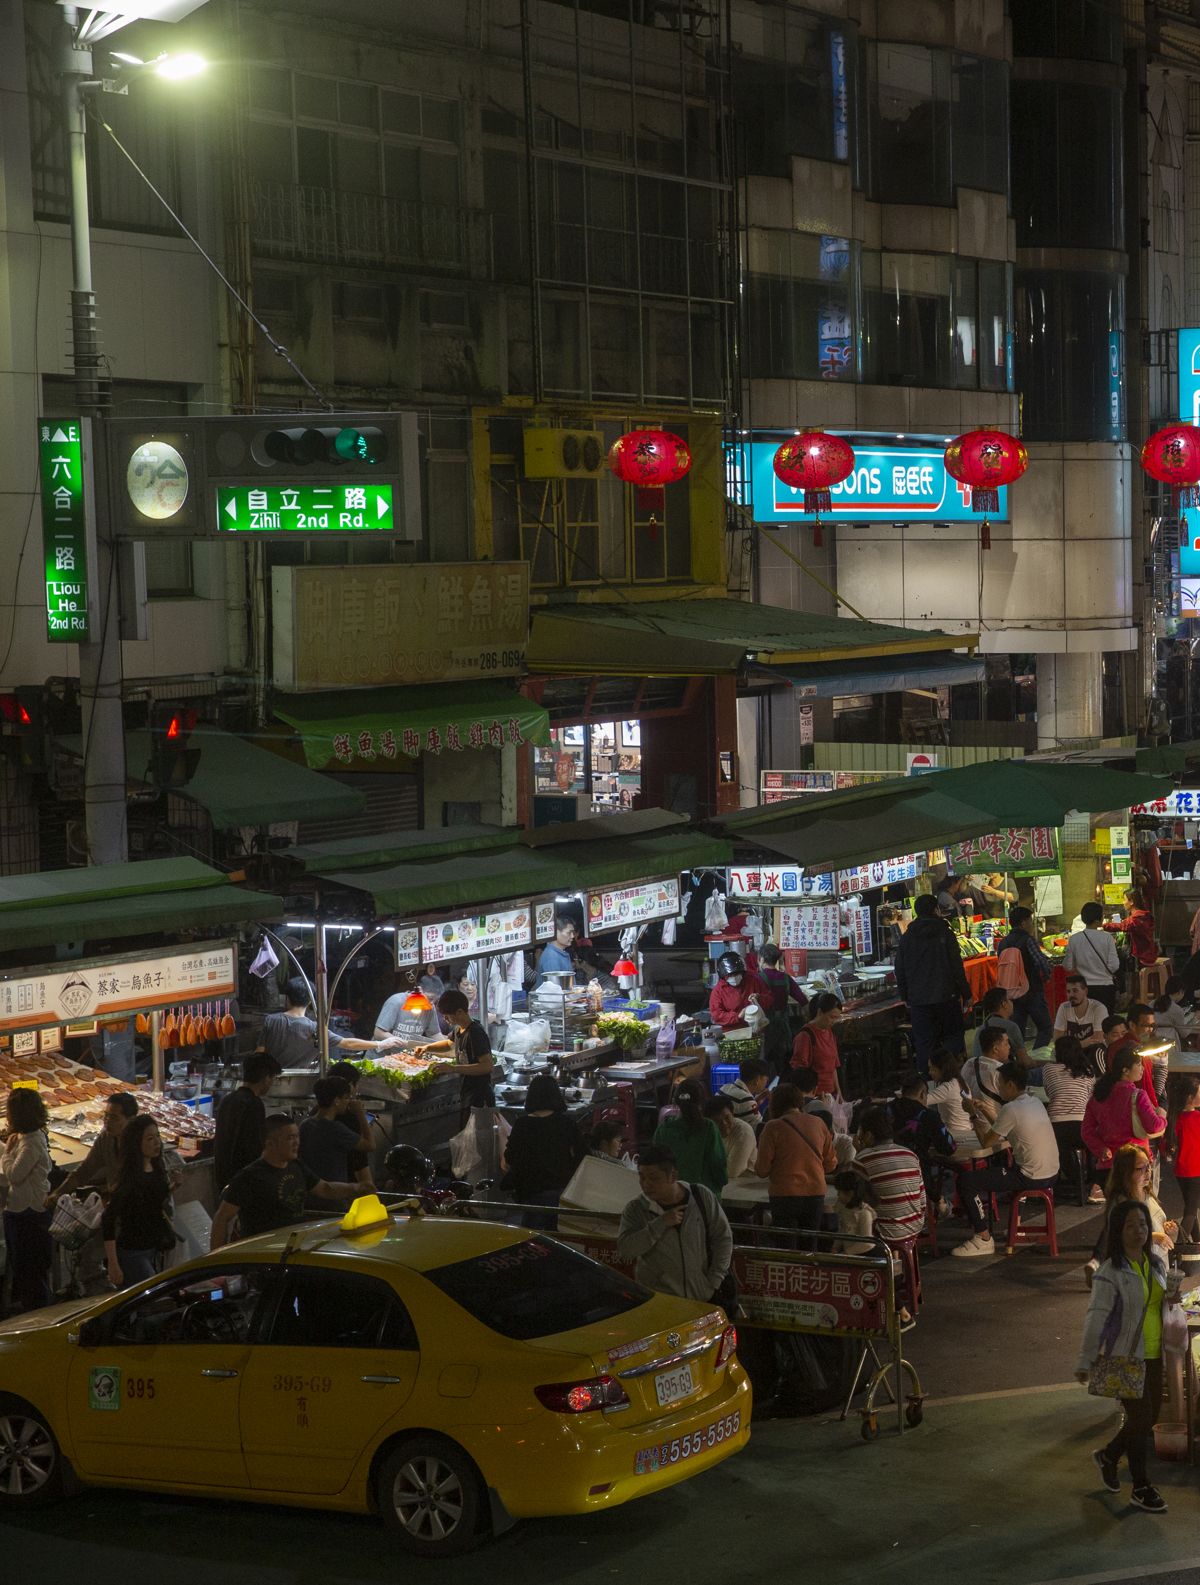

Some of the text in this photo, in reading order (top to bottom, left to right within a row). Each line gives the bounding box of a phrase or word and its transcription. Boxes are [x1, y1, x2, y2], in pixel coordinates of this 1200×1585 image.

[41, 427, 50, 442] 東
[68, 426, 80, 442] E.
[893, 466, 933, 496] 屈臣氏
[247, 488, 367, 510] 自立二路
[50, 455, 76, 571] 六合二路
[250, 513, 370, 528] Zihli 2nd Rd.
[53, 583, 81, 596] Liou
[58, 600, 77, 612] He
[50, 617, 88, 630] 2nd Rd.
[127, 1377, 156, 1400] 395
[669, 1410, 741, 1463] 555-5555
